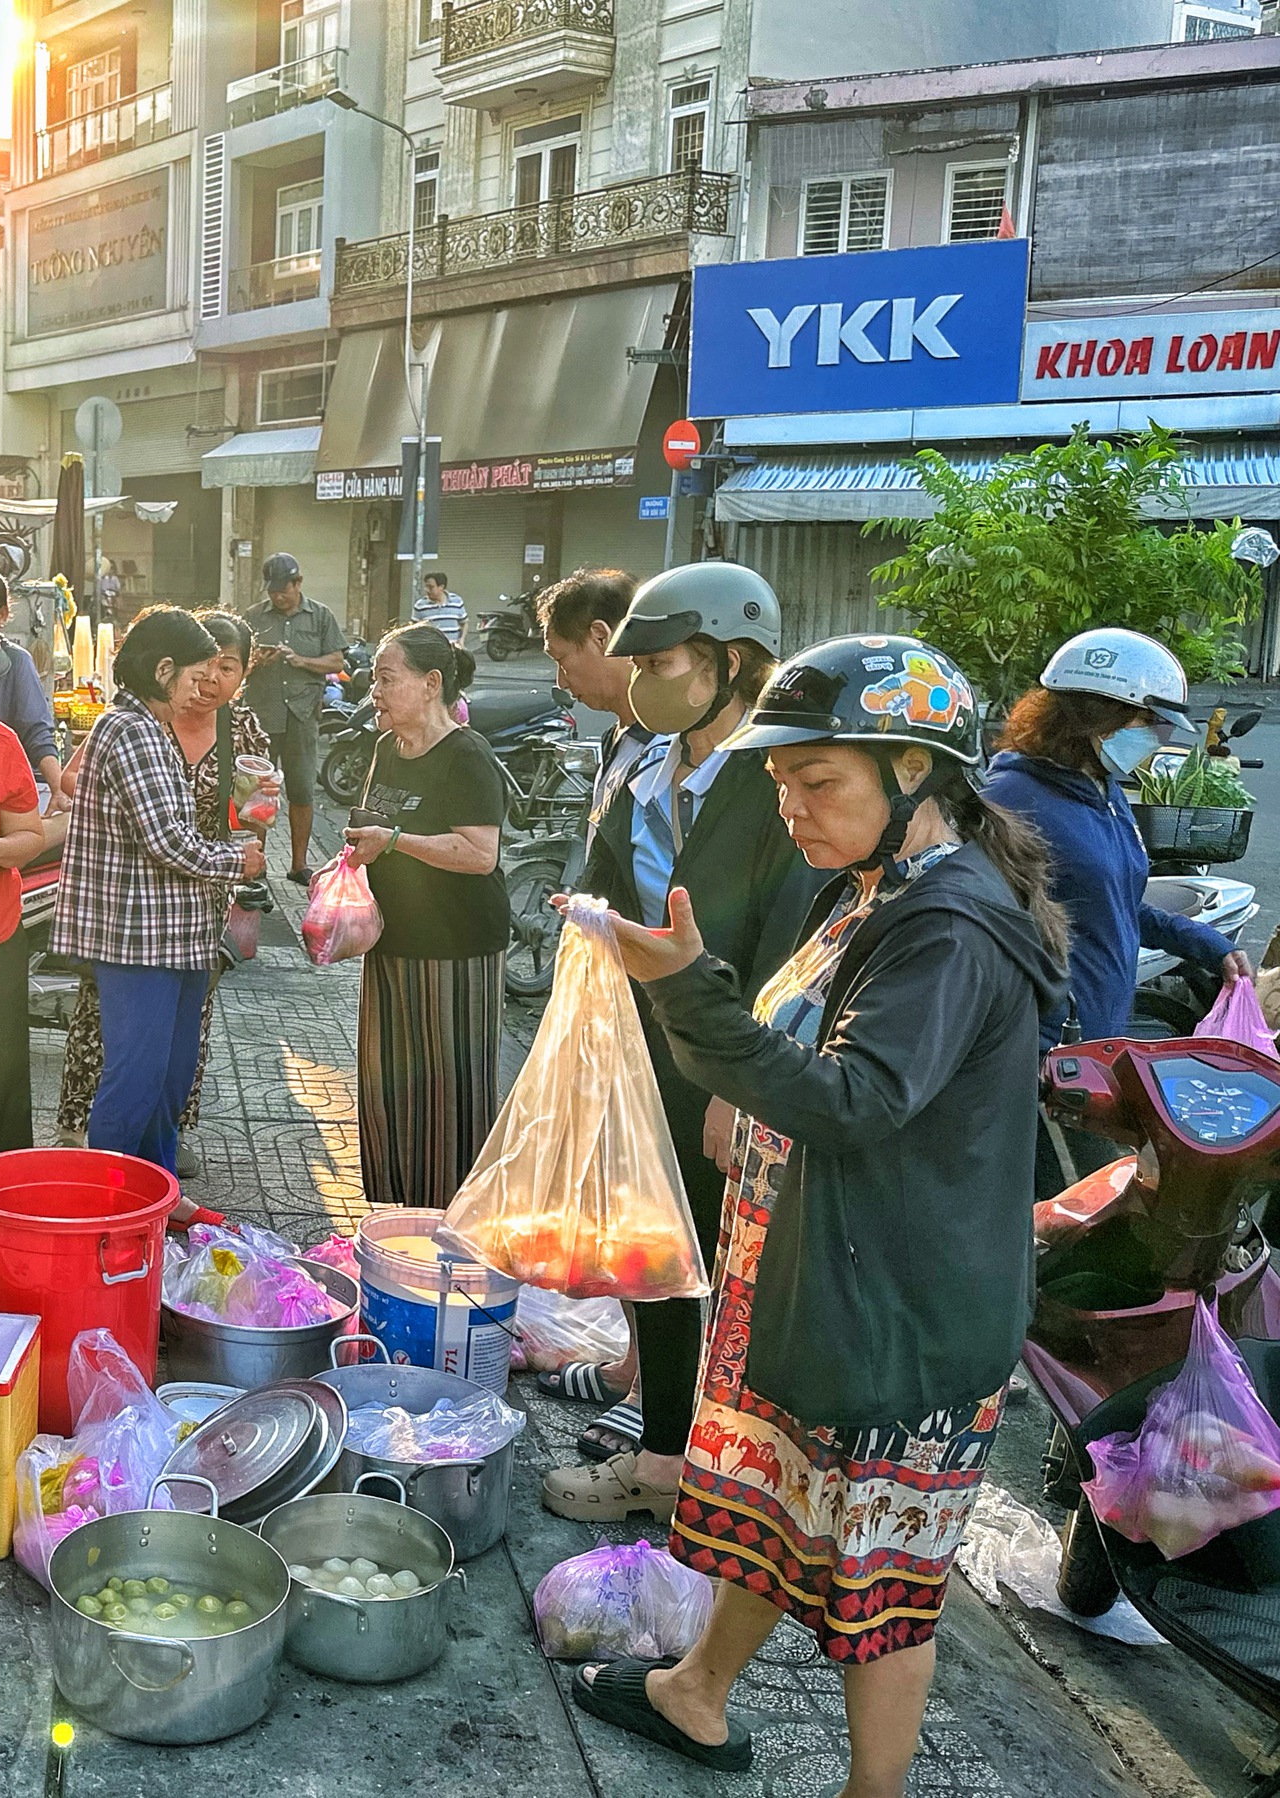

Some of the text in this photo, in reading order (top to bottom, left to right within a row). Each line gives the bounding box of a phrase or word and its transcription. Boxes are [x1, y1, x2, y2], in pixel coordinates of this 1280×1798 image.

[746, 293, 964, 369] YKK
[1035, 329, 1280, 380] KHOA LOAN
[346, 472, 362, 498] CỬA
[364, 472, 387, 498] HÀNG
[441, 462, 489, 495] THUẬN
[491, 459, 532, 487] PHÁT
